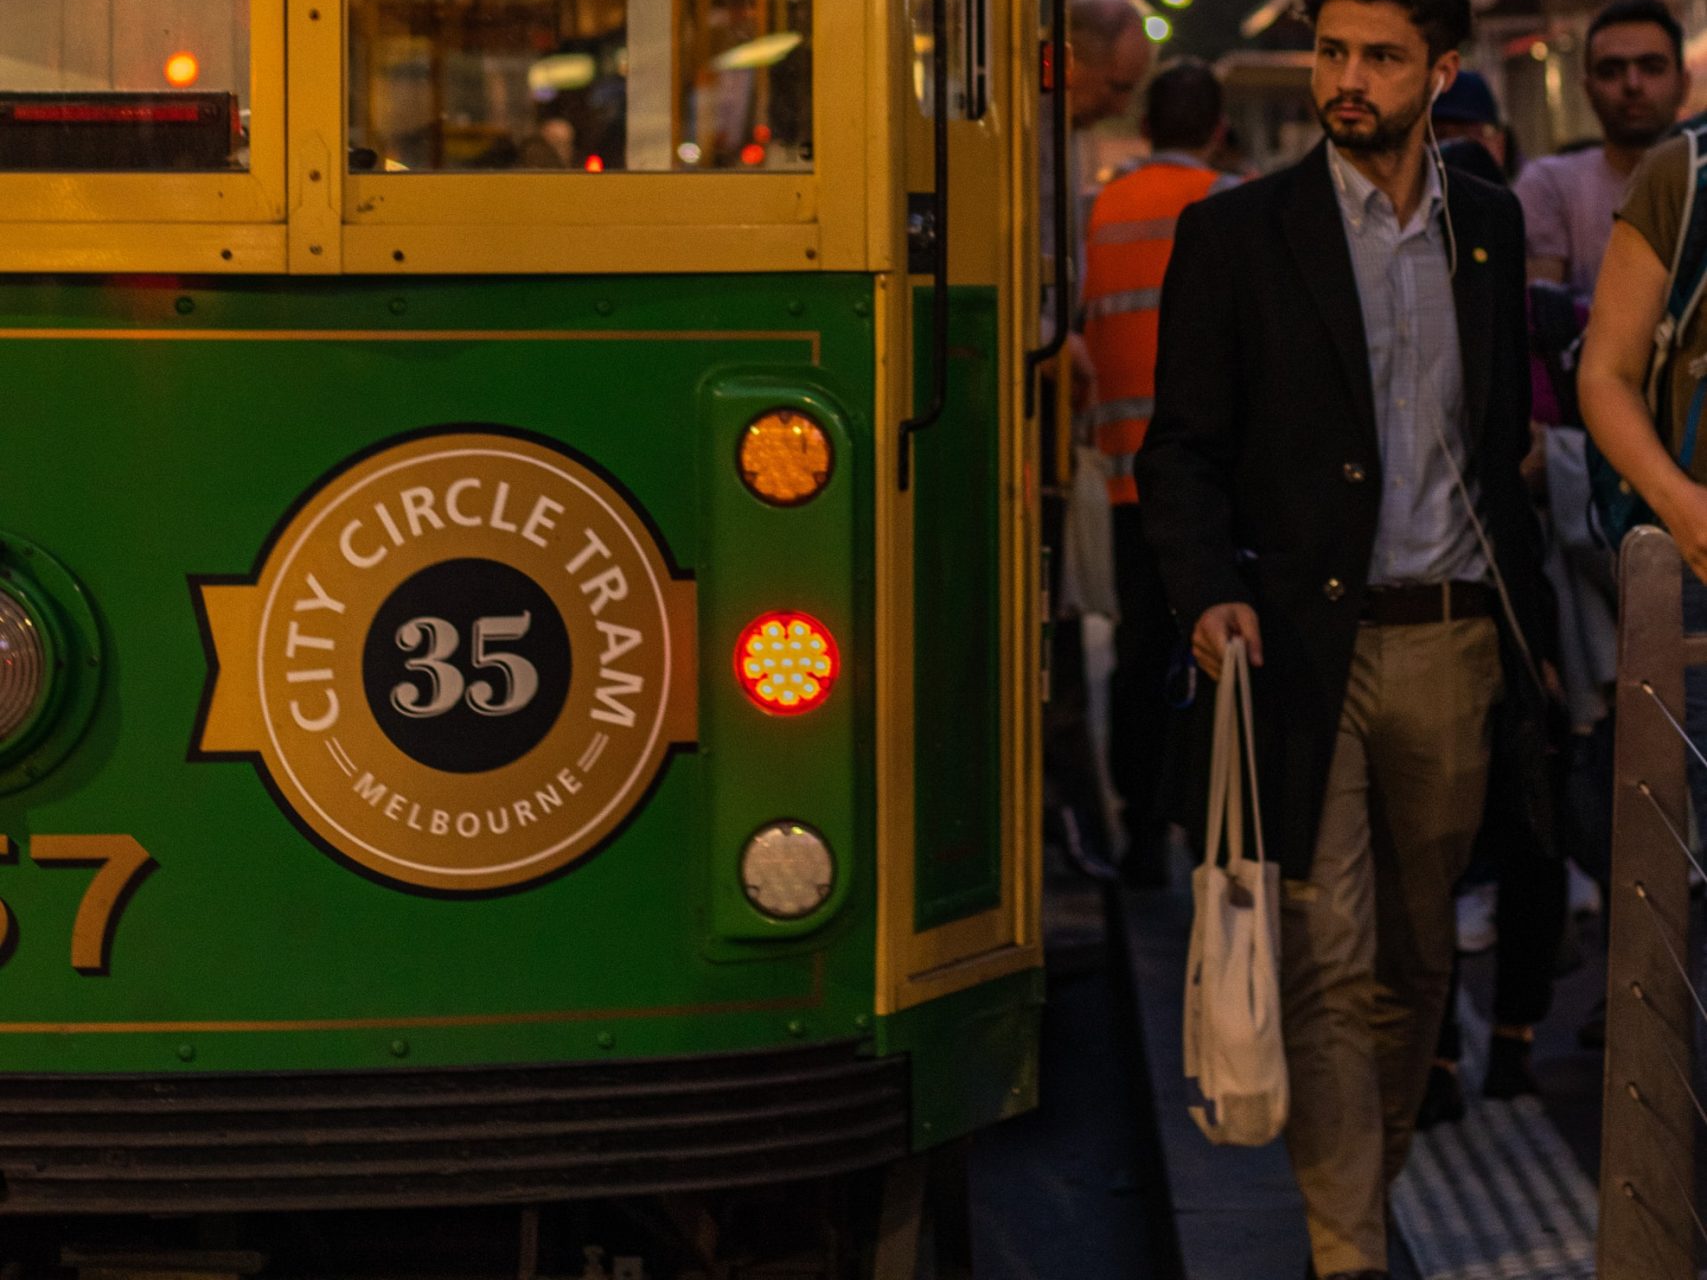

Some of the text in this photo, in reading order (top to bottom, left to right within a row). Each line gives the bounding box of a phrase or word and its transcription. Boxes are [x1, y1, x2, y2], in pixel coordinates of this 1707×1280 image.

[286, 478, 644, 732] CITY CIRCLE TRAM
[390, 611, 539, 717] 35
[353, 768, 583, 838] MELBOURNE
[0, 834, 158, 975] 7
